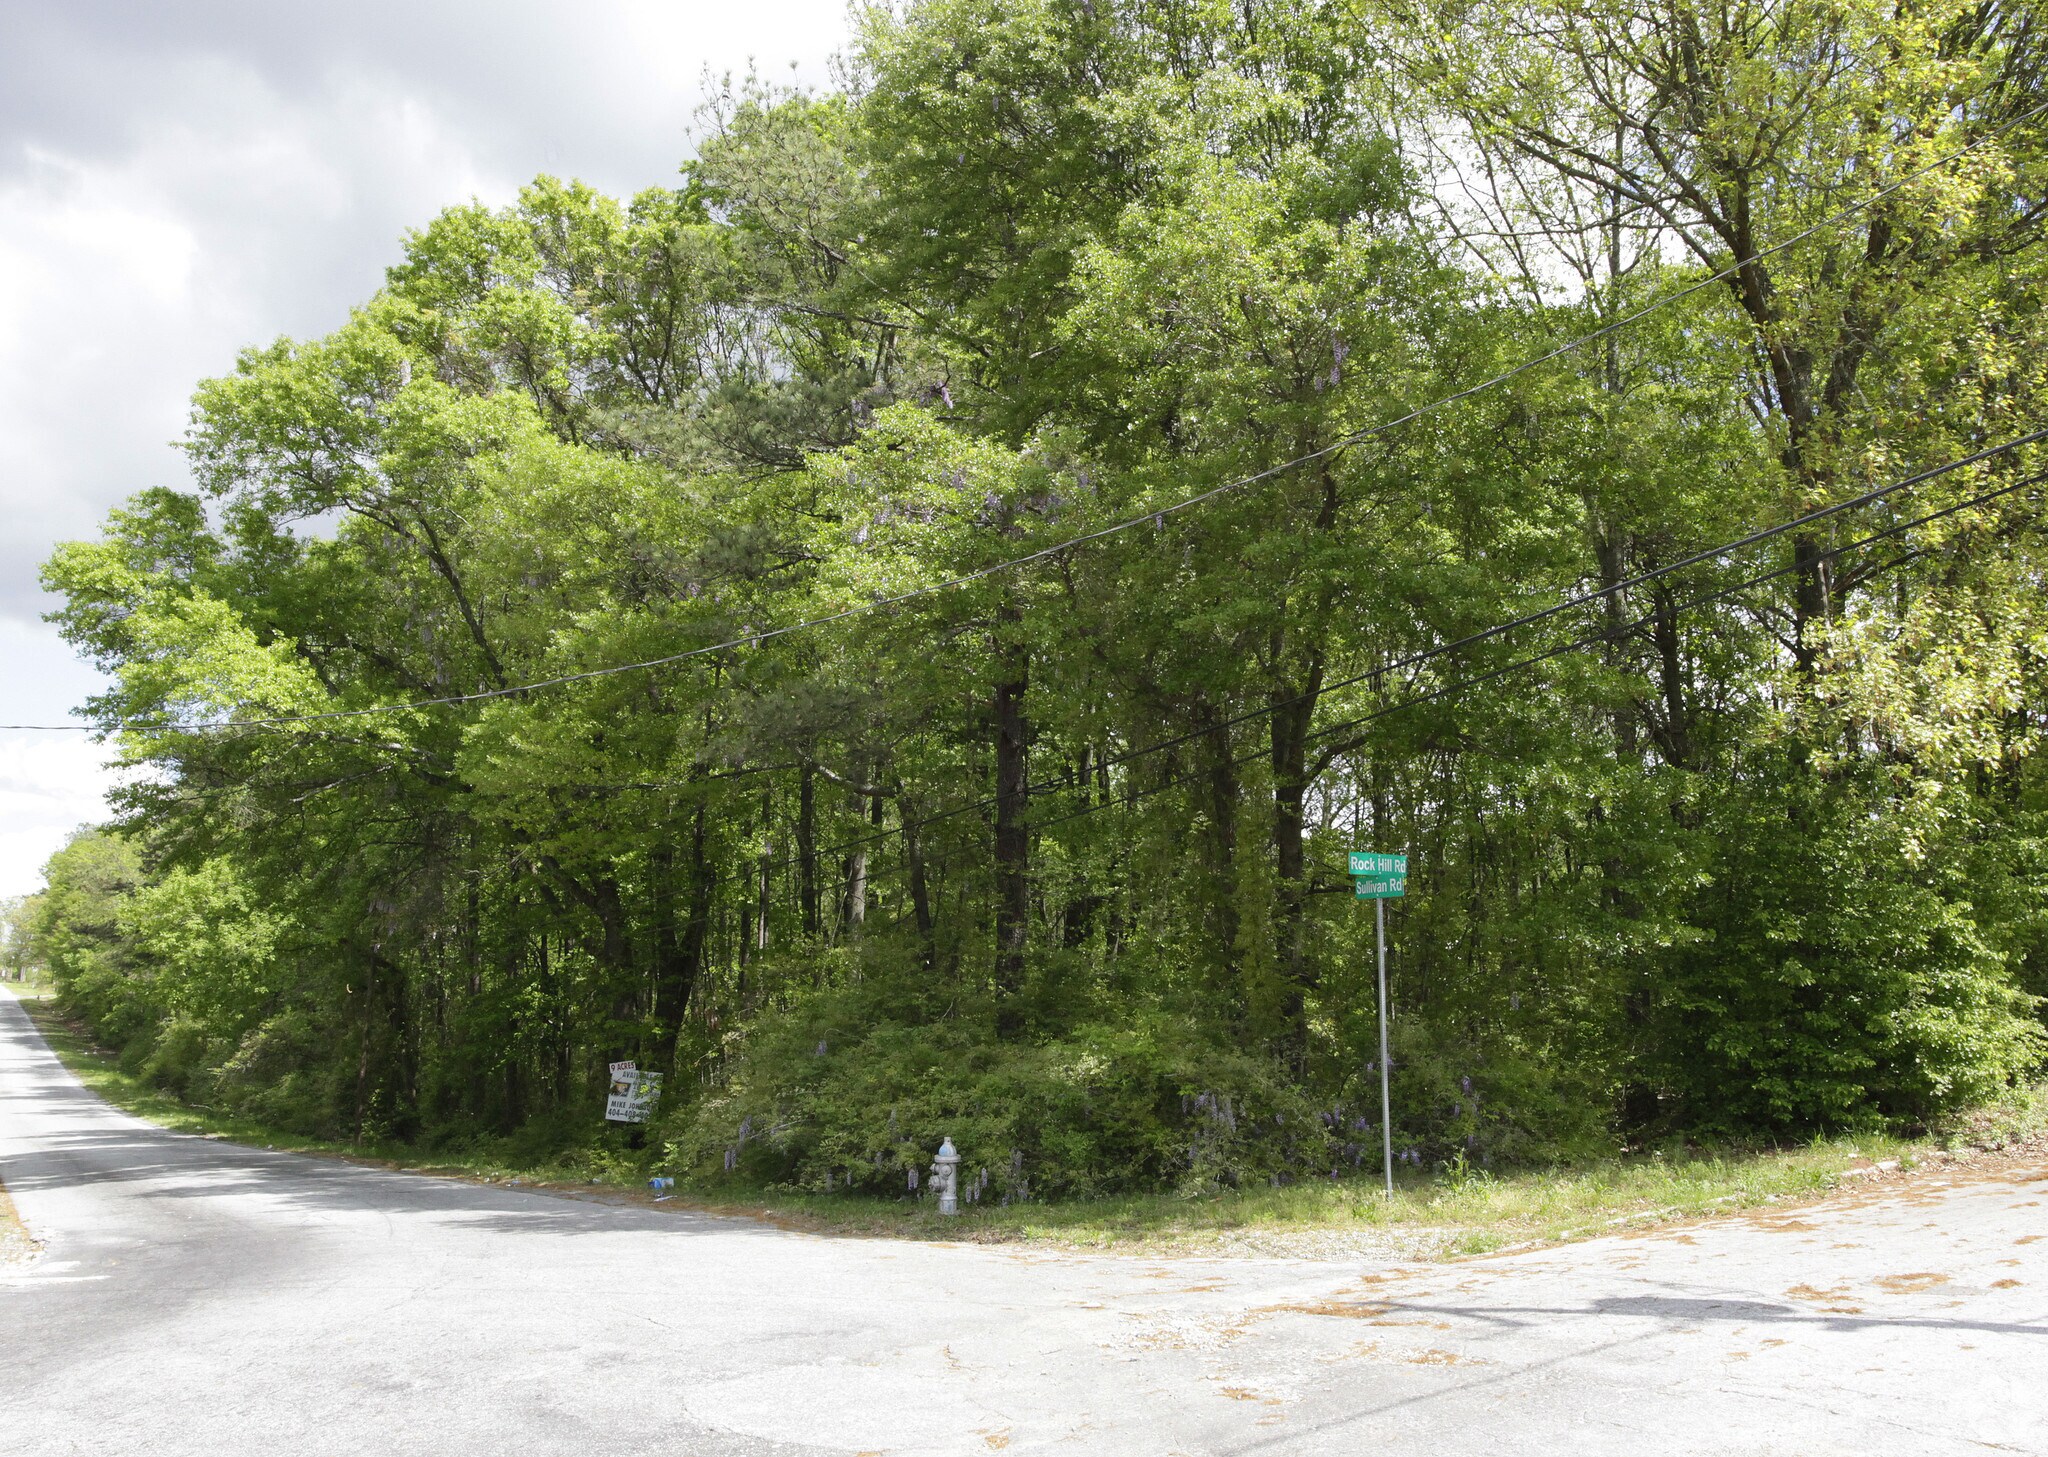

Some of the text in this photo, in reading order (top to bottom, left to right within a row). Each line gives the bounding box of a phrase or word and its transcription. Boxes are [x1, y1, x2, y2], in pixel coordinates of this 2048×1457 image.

[1351, 856, 1406, 873] Rock Hill Rd
[1356, 877, 1402, 895] Sullivan Rd
[610, 1062, 635, 1072] 9 ACRES
[610, 1100, 626, 1109] MIKE
